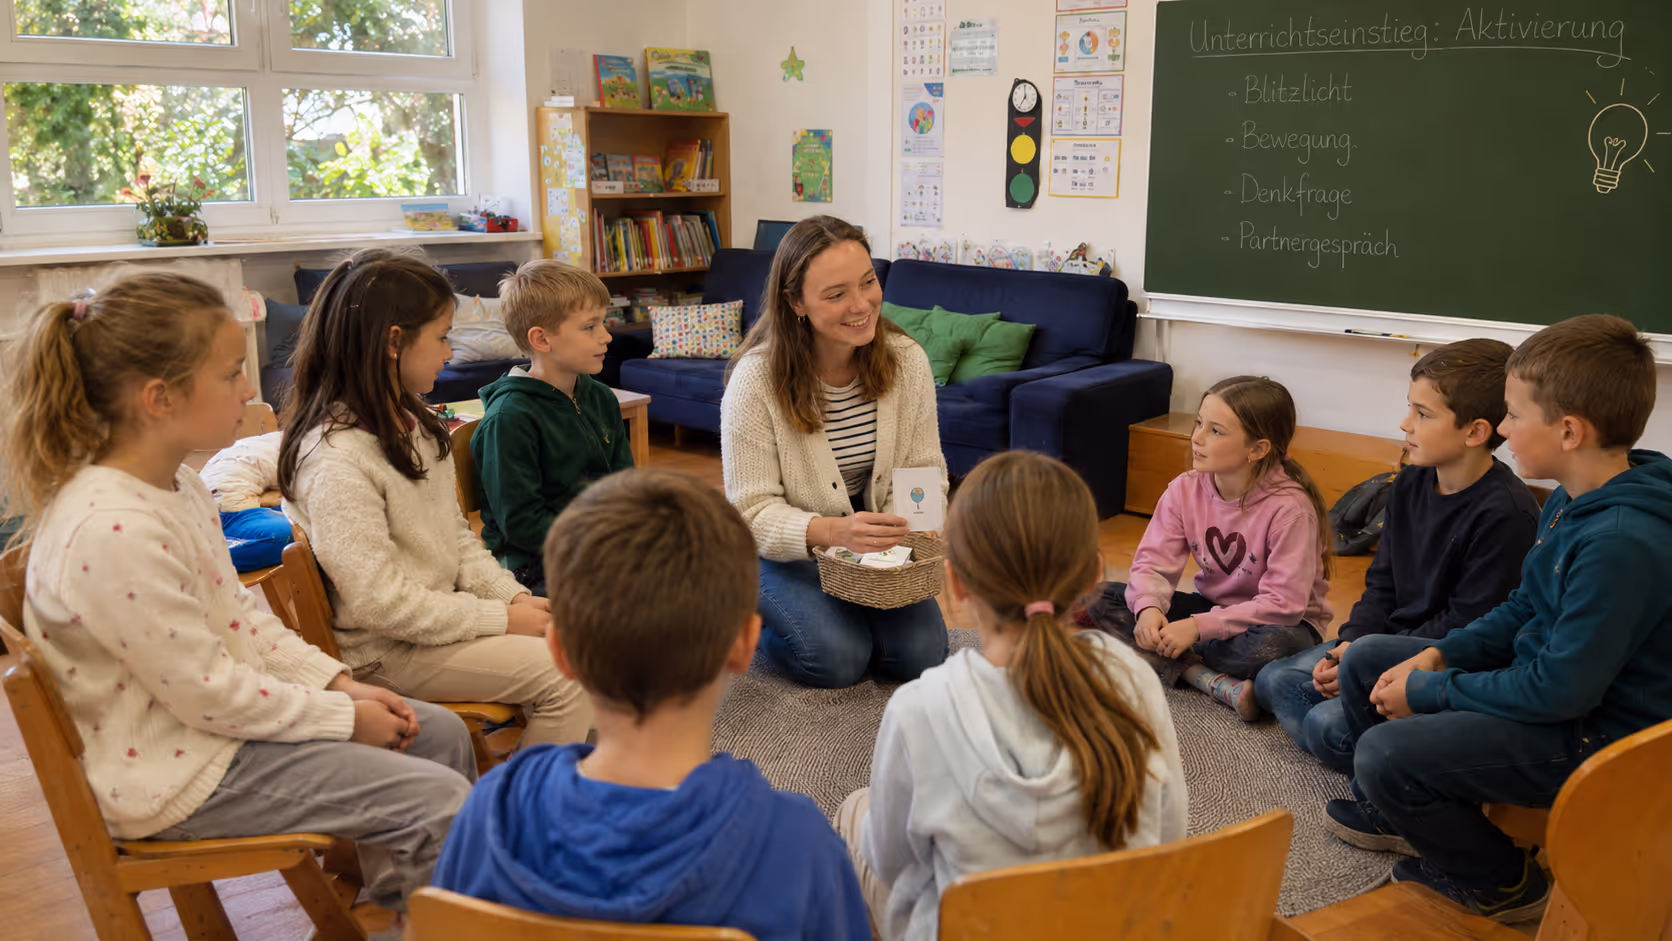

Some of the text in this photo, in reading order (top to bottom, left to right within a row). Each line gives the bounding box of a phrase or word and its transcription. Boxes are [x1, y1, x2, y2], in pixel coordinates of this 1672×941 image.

[1189, 7, 1626, 68] Unterrichtseinstieg: Aktivierung
[1245, 73, 1353, 104] Blitzlicht
[1240, 173, 1353, 220] Denkfrage
[1240, 221, 1399, 268] Partnergespräch
